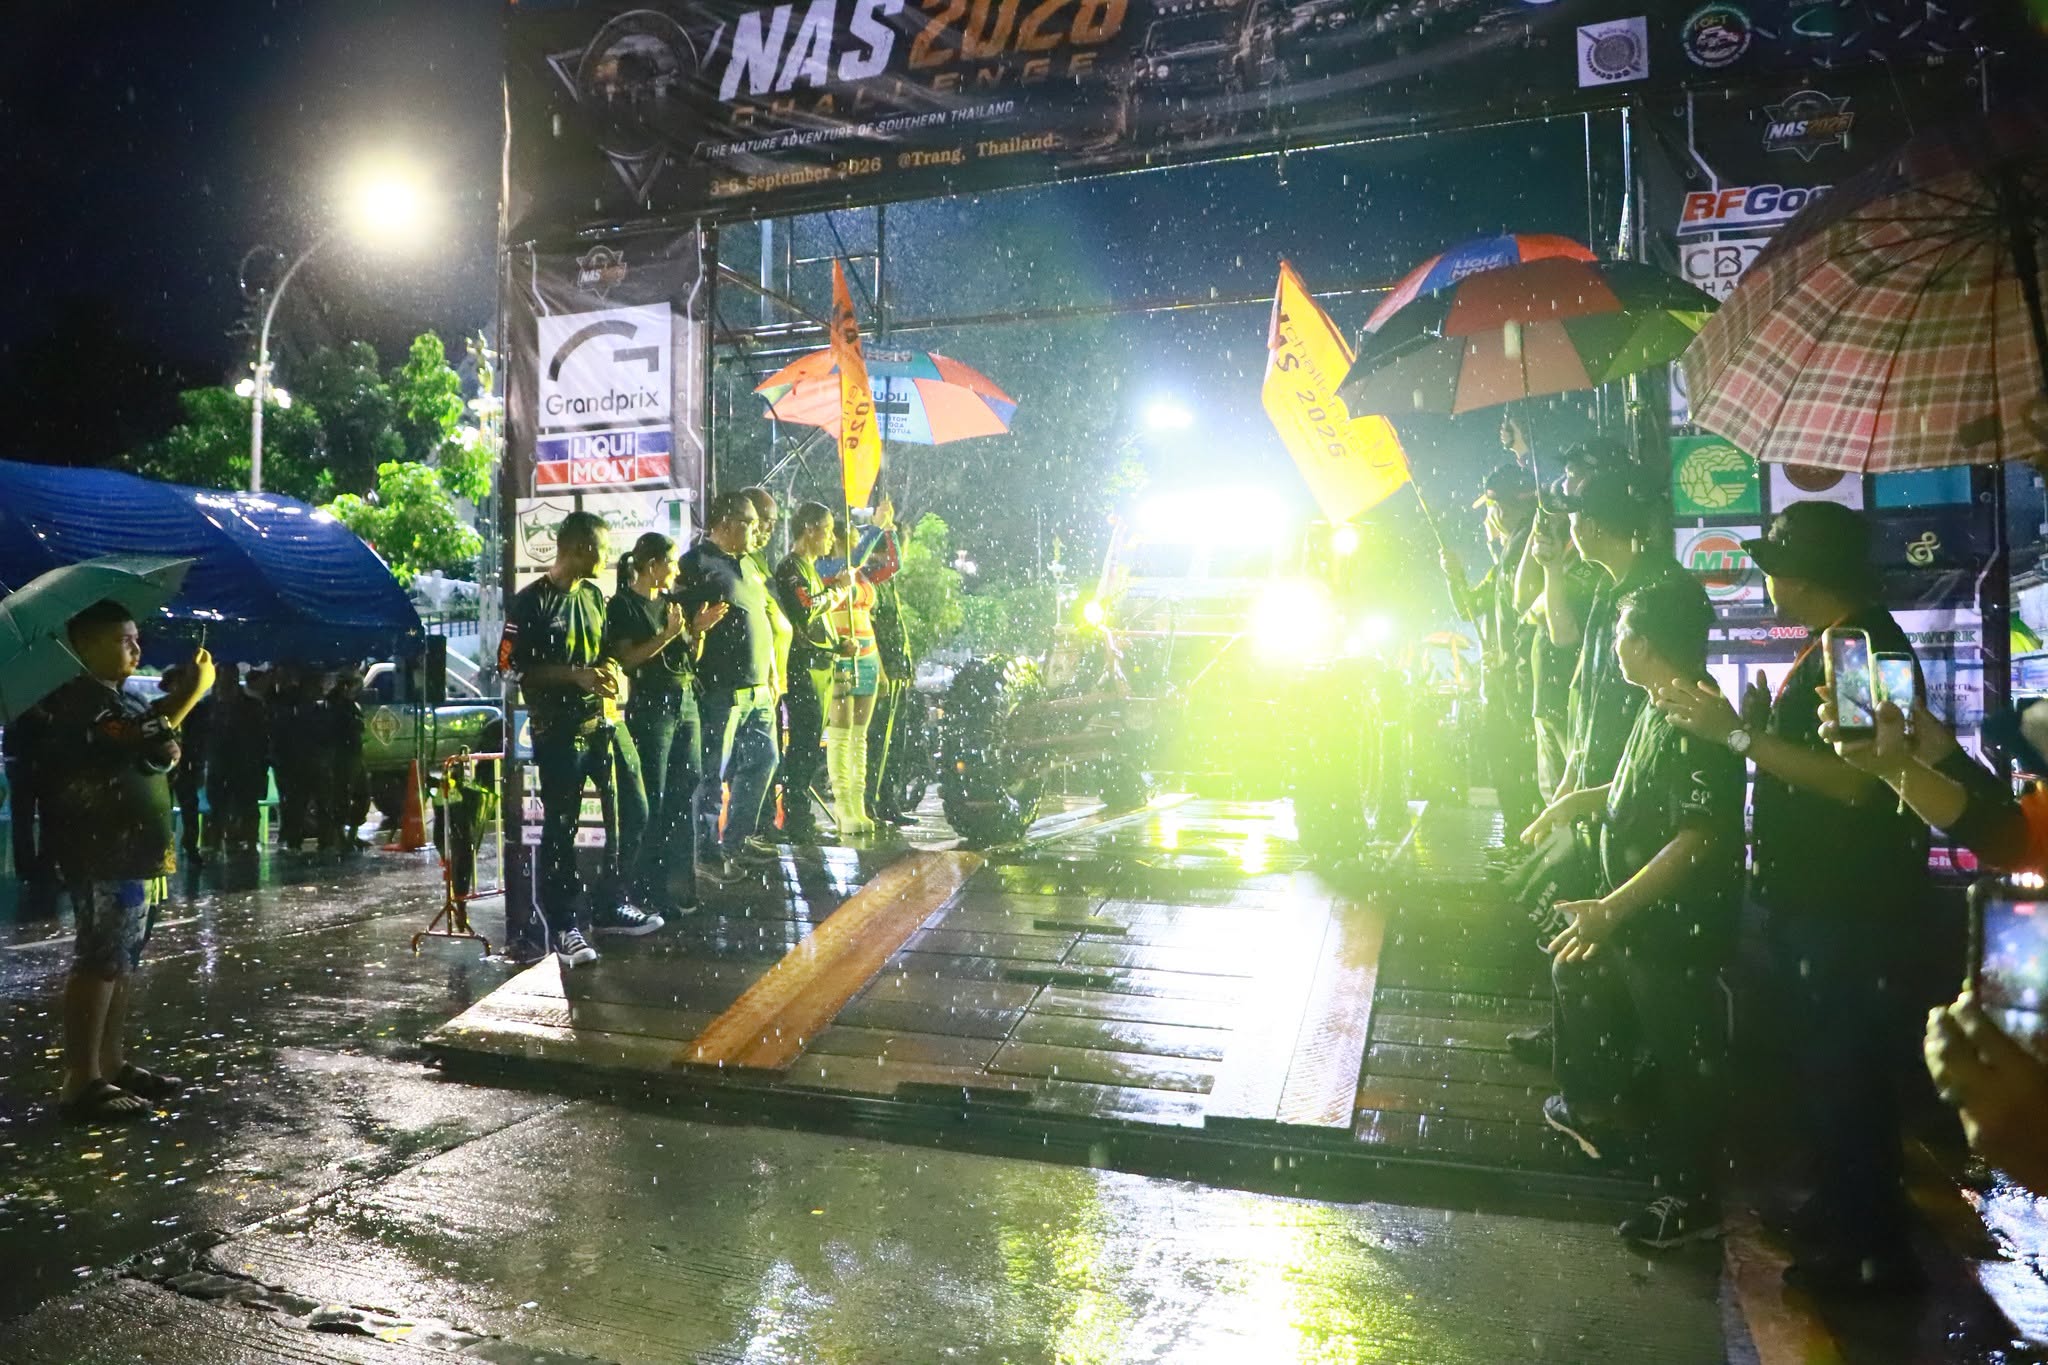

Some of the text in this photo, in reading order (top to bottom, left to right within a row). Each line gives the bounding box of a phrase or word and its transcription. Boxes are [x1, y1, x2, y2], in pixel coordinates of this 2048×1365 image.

[719, 0, 904, 101] NAS
[705, 101, 1014, 158] THE NATURE ADVENTURE OF SOUTHERN THAILAND
[1768, 121, 1808, 140] NAS
[747, 165, 831, 193] September
[837, 157, 882, 178] 2026
[1683, 185, 1808, 222] BFGo
[1685, 246, 1764, 278] CB
[1703, 280, 1734, 293] HA
[546, 386, 659, 416] Grandprix
[1296, 390, 1346, 457] 2026
[573, 434, 633, 459] LIQUI
[573, 459, 634, 483] MOLY
[1728, 628, 1768, 641] PRO
[1768, 627, 1809, 639] 4WD
[1907, 631, 1977, 644] DWORK
[1928, 856, 1951, 866] sh
